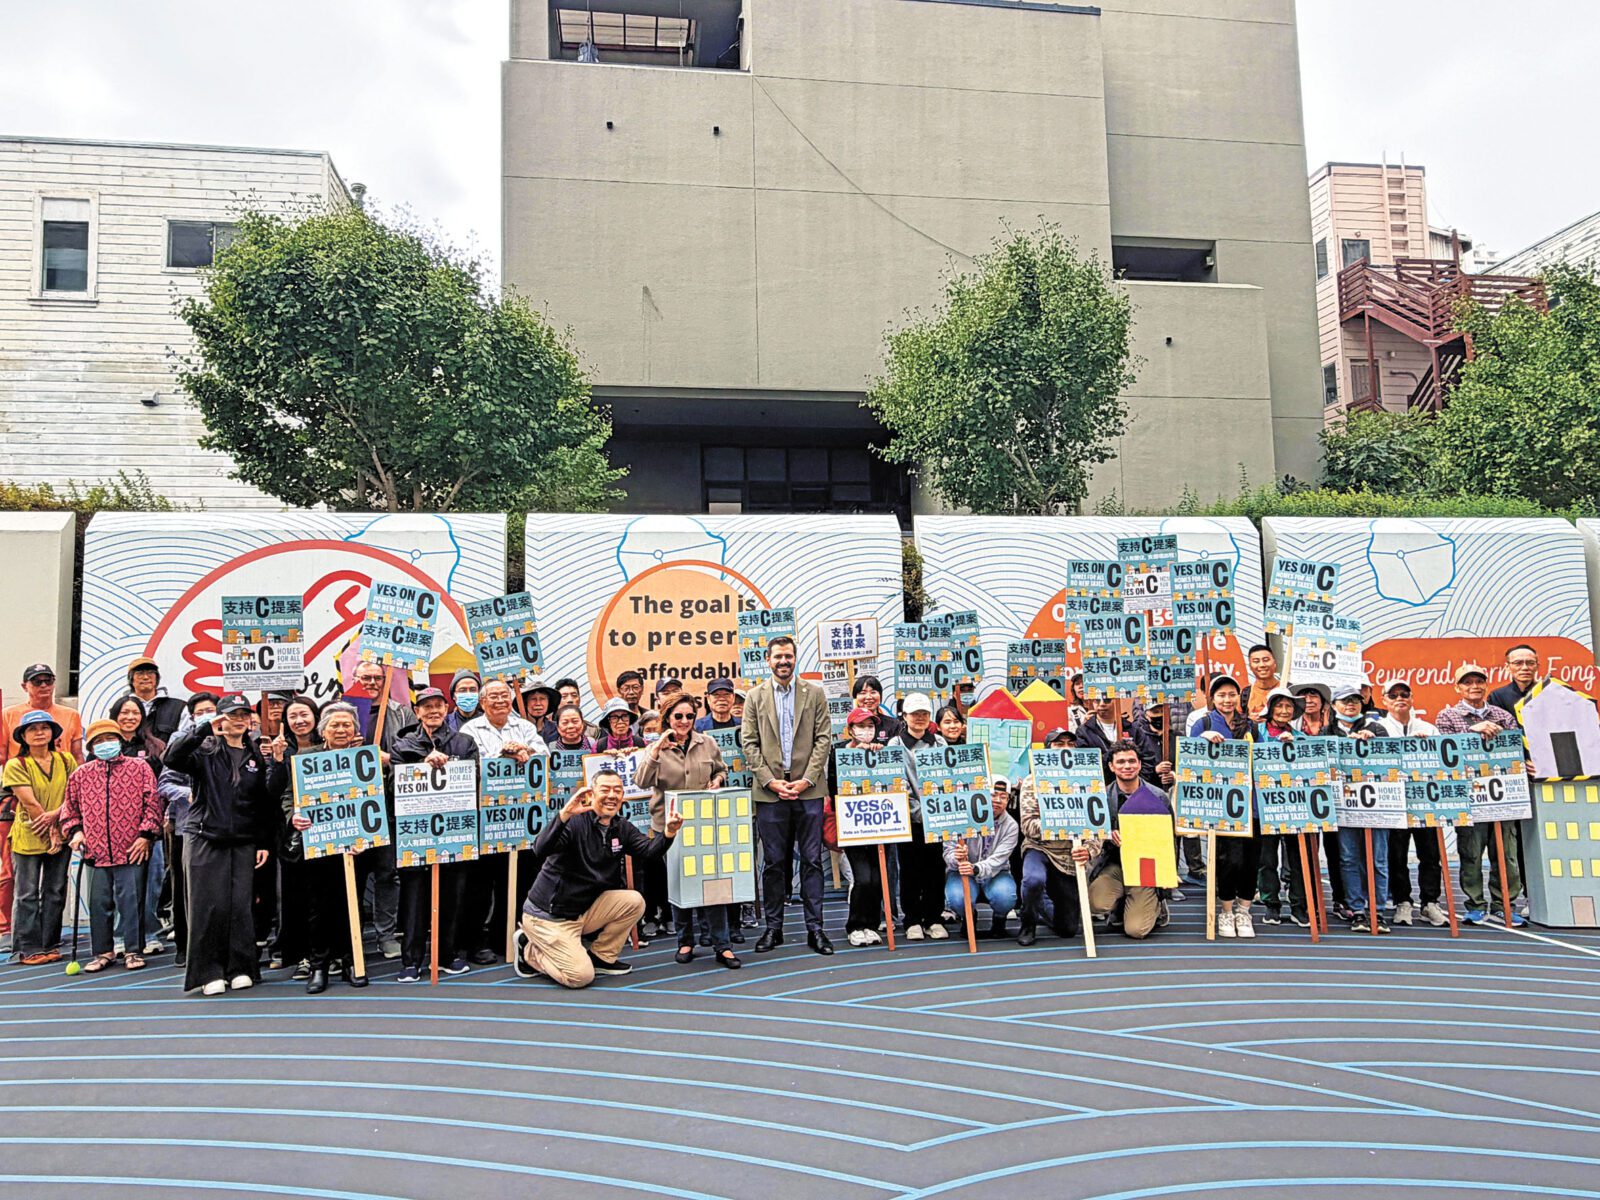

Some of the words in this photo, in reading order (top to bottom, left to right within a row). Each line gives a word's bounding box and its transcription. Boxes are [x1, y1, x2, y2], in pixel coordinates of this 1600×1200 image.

[1118, 538, 1176, 554] 支持C提案
[1072, 562, 1088, 573] YES
[1092, 563, 1104, 573] ON
[1107, 564, 1121, 587] C
[1146, 575, 1158, 593] C
[1174, 564, 1192, 576] YES
[1196, 564, 1209, 574] ON
[1213, 562, 1228, 587] C
[1279, 561, 1298, 572] YES
[1301, 564, 1316, 575] ON
[1317, 566, 1334, 591] C
[224, 597, 302, 618] 支持C提案
[377, 584, 397, 597] YES
[400, 588, 415, 601] ON
[416, 593, 434, 618] C
[467, 596, 531, 619] 支持C提案
[630, 595, 673, 613] The
[680, 595, 730, 618] goal
[738, 595, 756, 613] is
[1067, 598, 1123, 614] 支持C提案
[738, 610, 794, 626] 支持C提案
[1177, 603, 1195, 614] YES
[1198, 602, 1212, 612] ON
[1216, 601, 1231, 625] C
[1295, 614, 1360, 631] 支持C提案
[363, 624, 431, 647] 支持C提案
[609, 629, 636, 646] to
[648, 629, 736, 651] preser
[831, 624, 864, 638] 支持1
[895, 625, 951, 640] 支持C提案
[1084, 619, 1104, 630] YES
[1107, 618, 1121, 629] ON
[1125, 617, 1141, 643] C
[1160, 630, 1173, 640] ON
[1176, 629, 1191, 653] C
[225, 662, 241, 671] YES
[244, 662, 255, 671] ON
[259, 646, 274, 670] C
[480, 642, 494, 660] Sí
[496, 645, 504, 656] a
[506, 641, 518, 654] la
[521, 637, 538, 663] C
[744, 651, 761, 661] YES
[1008, 640, 1064, 656] 支持C提案
[965, 649, 979, 672] C
[1084, 658, 1146, 676] 支持C提案
[1196, 659, 1240, 676] nity.
[1323, 651, 1336, 669] C
[637, 663, 741, 680] affordabl
[824, 671, 835, 679] YES
[899, 664, 916, 674] YES
[919, 664, 931, 674] ON
[934, 664, 948, 688] C
[1148, 666, 1195, 682] 持C提案
[1362, 660, 1454, 686] Reverend
[1547, 657, 1596, 690] Fong
[838, 749, 903, 768] 支持C提案
[917, 747, 983, 767] 支持C提案
[1033, 750, 1099, 769] 支持C提案
[1180, 741, 1248, 759] 支持C提案
[1253, 742, 1325, 762] 支持C提案
[1339, 739, 1400, 758] 持C提案
[1401, 740, 1417, 752] ES
[1420, 739, 1436, 751] ON
[1441, 738, 1458, 768] C
[302, 757, 318, 775] Sí
[323, 759, 332, 772] a
[336, 754, 350, 770] la
[355, 750, 375, 782] C
[487, 761, 500, 777] Sí
[504, 765, 511, 776] a
[529, 759, 542, 789] C
[398, 785, 413, 793] YES
[416, 783, 428, 792] ON
[431, 767, 447, 791] C
[1476, 794, 1487, 802] ON
[1489, 778, 1504, 801] C
[1183, 786, 1203, 799] YES
[1207, 787, 1222, 800] ON
[1227, 789, 1244, 818] C
[1263, 792, 1285, 804] YES
[1289, 791, 1306, 803] ON
[1310, 789, 1329, 819] C
[1346, 800, 1358, 808] ON
[1360, 785, 1376, 808] C
[307, 807, 333, 823] YES
[337, 803, 356, 819] ON
[361, 800, 382, 833] C
[845, 800, 879, 817] yes
[855, 812, 891, 826] PROP
[893, 811, 901, 823] 1
[927, 798, 940, 814] Sí
[944, 800, 951, 812] a
[954, 796, 966, 811] la
[970, 794, 989, 823] C
[1044, 797, 1064, 809] YES
[1067, 797, 1083, 809] ON
[1087, 796, 1105, 826] C
[309, 823, 331, 833] HOMES
[333, 821, 346, 830] FOR
[347, 819, 358, 828] ALL
[398, 814, 475, 836] 支持C提案
[486, 809, 506, 822] YES
[510, 808, 524, 820] ON
[527, 806, 542, 835] C
[309, 835, 319, 843] NO
[321, 832, 337, 841] NEW
[339, 827, 359, 838] TAXES
[495, 831, 508, 839] NEW
